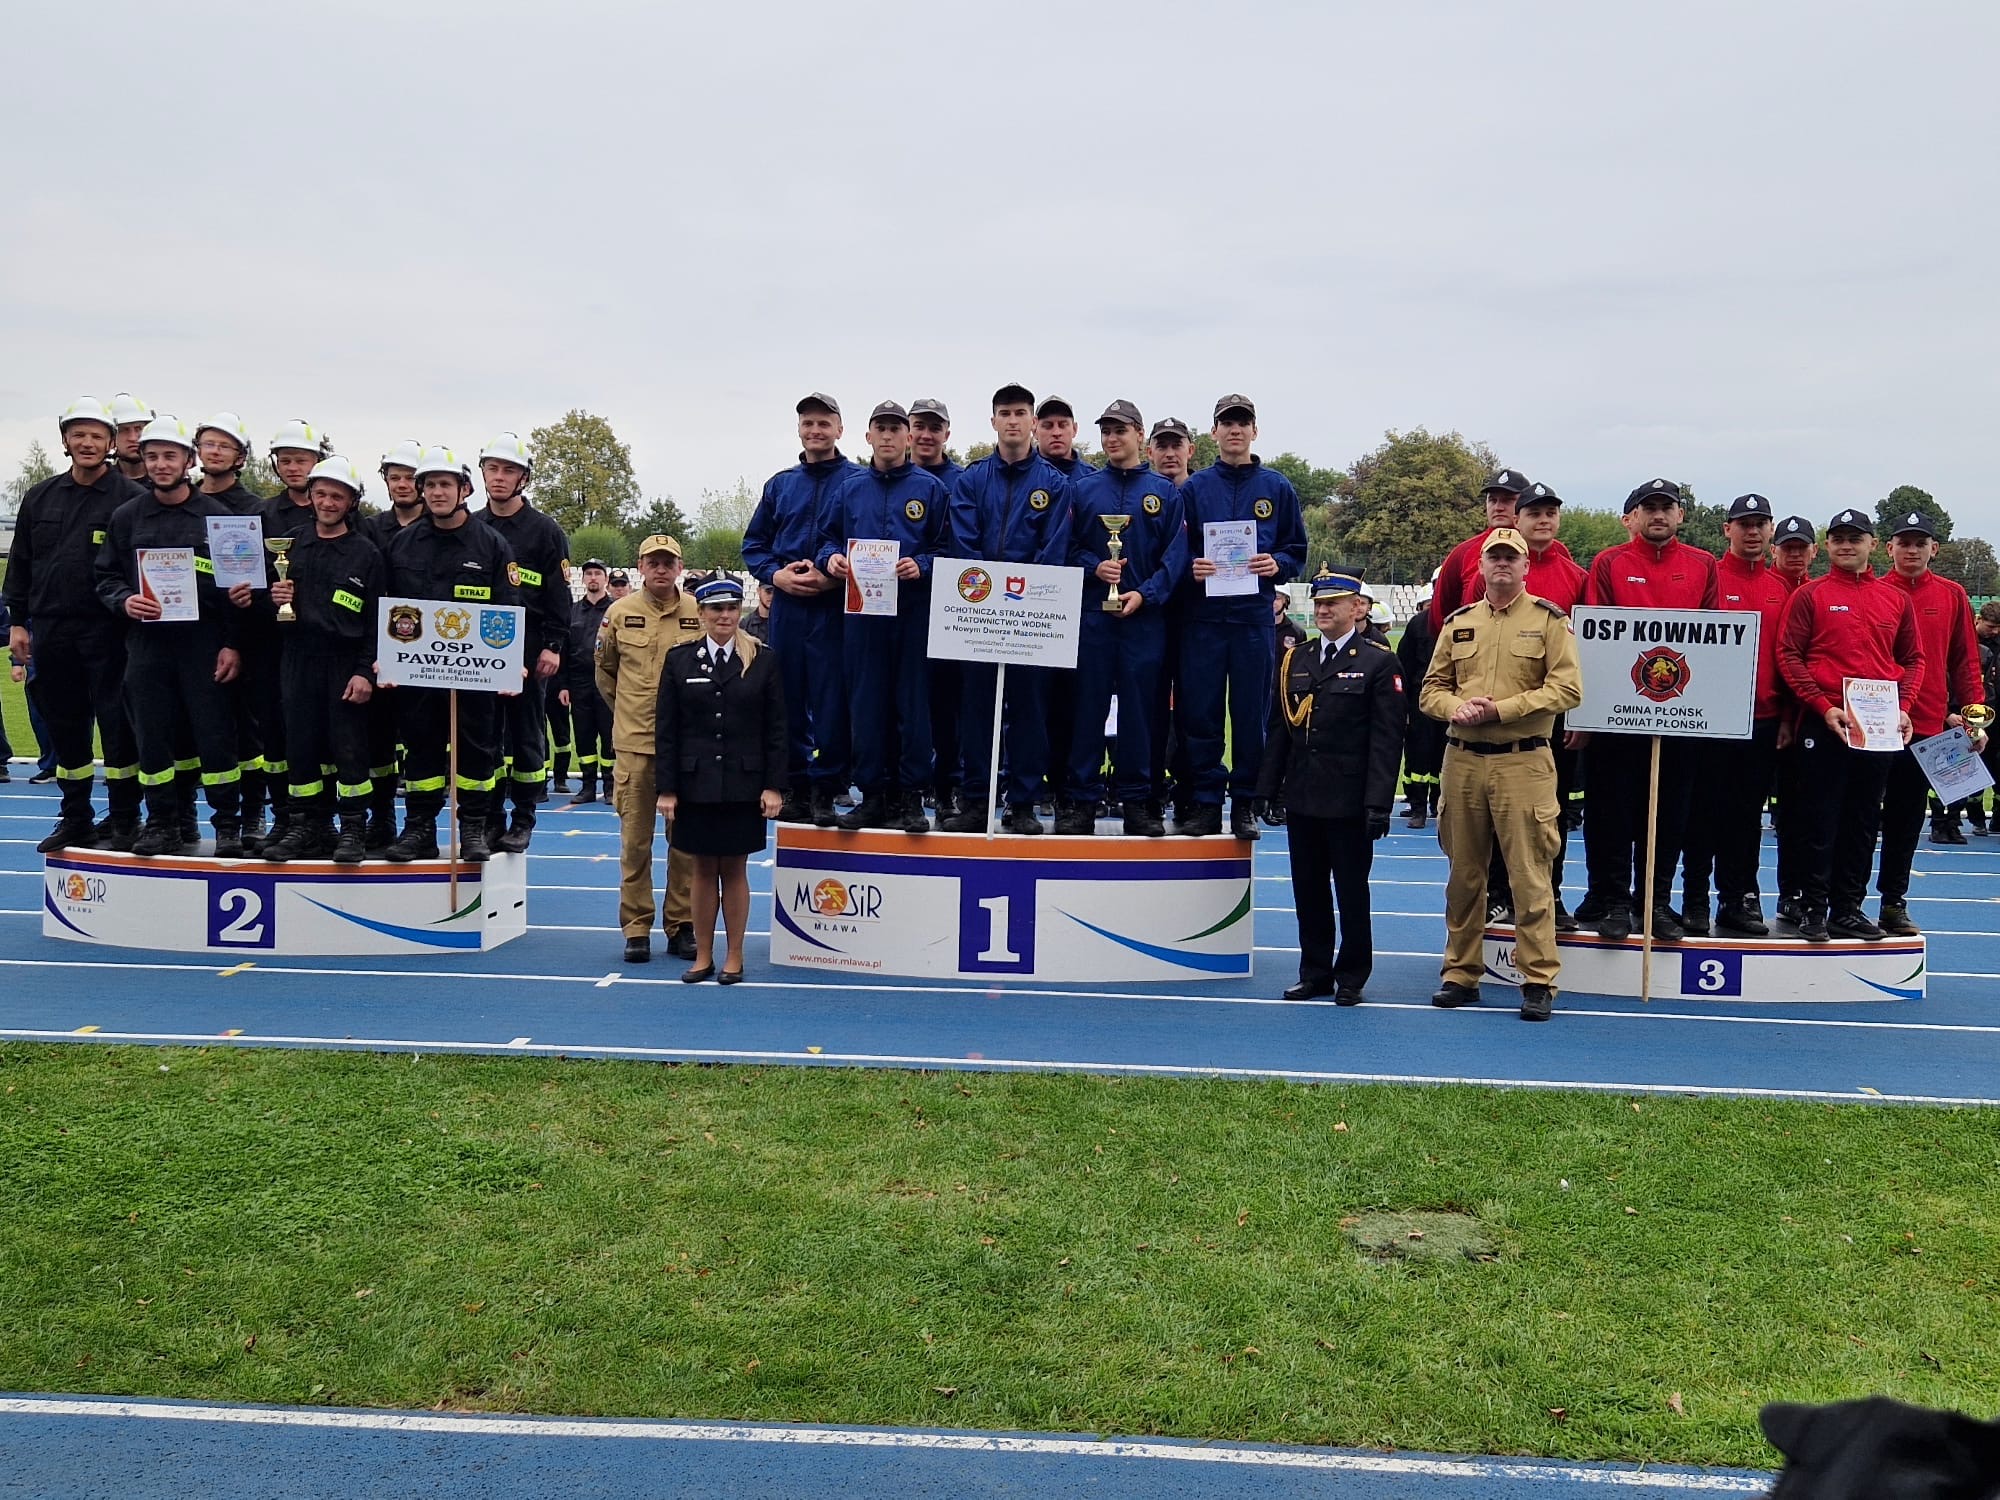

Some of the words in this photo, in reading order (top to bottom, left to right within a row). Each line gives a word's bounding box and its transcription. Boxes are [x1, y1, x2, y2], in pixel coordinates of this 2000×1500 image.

[856, 543, 893, 553] DYPLOM
[147, 552, 188, 561] DYPLOM
[195, 559, 213, 570] STR
[944, 605, 997, 616] OCHOTNICZA
[999, 608, 1026, 618] STRAŻ
[1027, 610, 1067, 621] POŻARNA
[957, 615, 1019, 627] RATOWNICTWO
[1021, 619, 1053, 629] WODNE
[952, 624, 981, 634] Nowym
[982, 626, 1011, 635] Dworze
[1013, 629, 1065, 640] Mazowieckim
[1582, 618, 1627, 641] OSP
[1632, 620, 1747, 645] KOWNATY
[430, 640, 474, 654] OSP
[396, 652, 507, 671] PAWŁOWO
[420, 666, 445, 674] gmina
[409, 672, 436, 680] powiat
[437, 674, 492, 684] ciechanowski
[1853, 682, 1892, 693] DYPLOM
[1613, 704, 1651, 715] GMINA
[1654, 706, 1704, 718] PŁOŃSK
[1607, 716, 1652, 727] POWIAT
[1655, 717, 1708, 730] PŁOŃSKI
[219, 887, 265, 943] 2
[977, 895, 1021, 963] 1
[788, 953, 882, 969] www.mosir.mlawa.pl
[1697, 959, 1726, 991] 3
